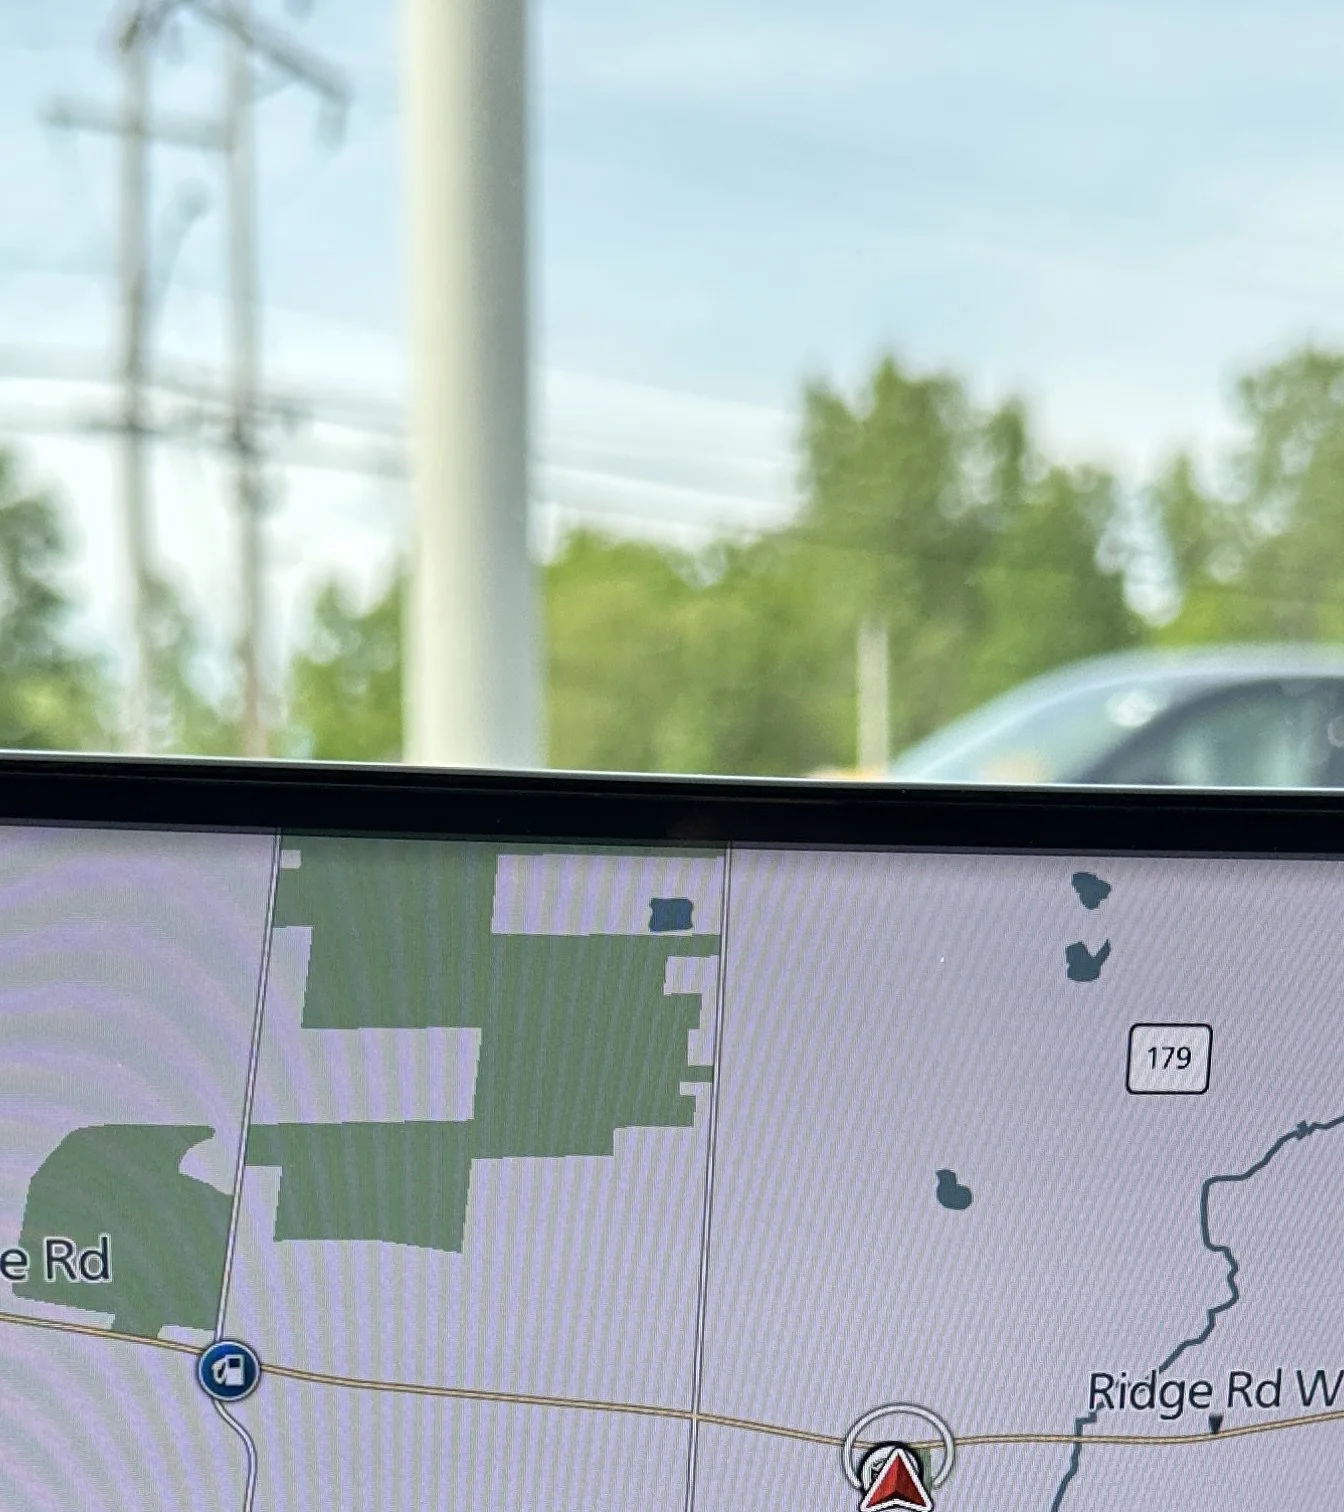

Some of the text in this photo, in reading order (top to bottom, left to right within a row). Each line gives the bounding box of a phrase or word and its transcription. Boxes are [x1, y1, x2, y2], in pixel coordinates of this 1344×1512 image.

[1147, 1046, 1192, 1070] 179
[45, 1234, 111, 1281] Rd
[1088, 1368, 1214, 1421] Ridge
[1227, 1367, 1283, 1408] Rd
